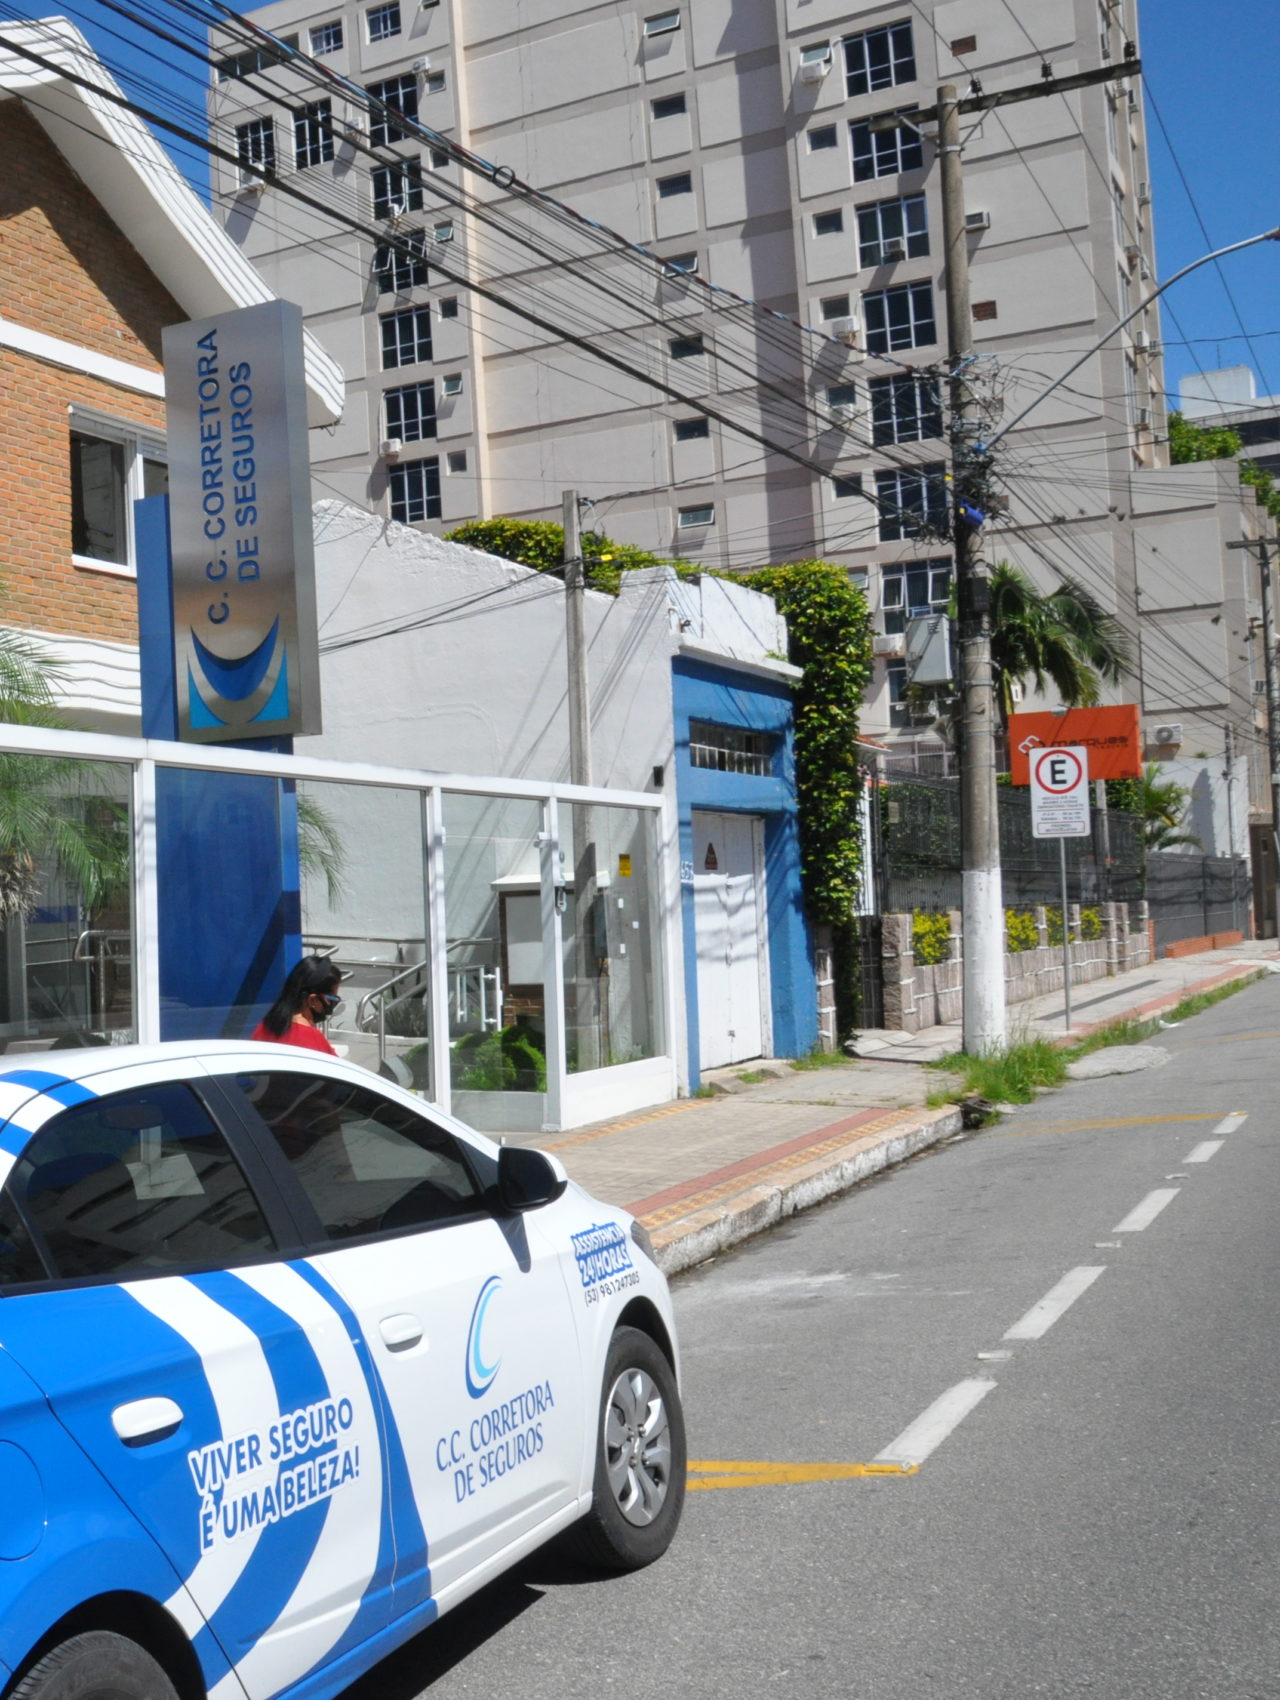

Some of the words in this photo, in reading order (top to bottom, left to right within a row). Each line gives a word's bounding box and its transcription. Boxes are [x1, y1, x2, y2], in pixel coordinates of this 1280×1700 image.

[197, 328, 226, 541] CORRETORA
[228, 361, 258, 526] SEGUROS
[237, 536, 260, 583] DE
[1050, 759, 1067, 785] E
[191, 1433, 262, 1490] VIVER
[269, 1397, 353, 1461] SEGURO
[436, 1430, 466, 1472] C.C.
[470, 1379, 554, 1452] CORRETORA
[454, 1462, 476, 1504] DE
[479, 1422, 544, 1488] SEGUROS
[202, 1499, 214, 1550] É
[223, 1485, 277, 1539] UMA
[284, 1445, 360, 1512] BELEZA!
